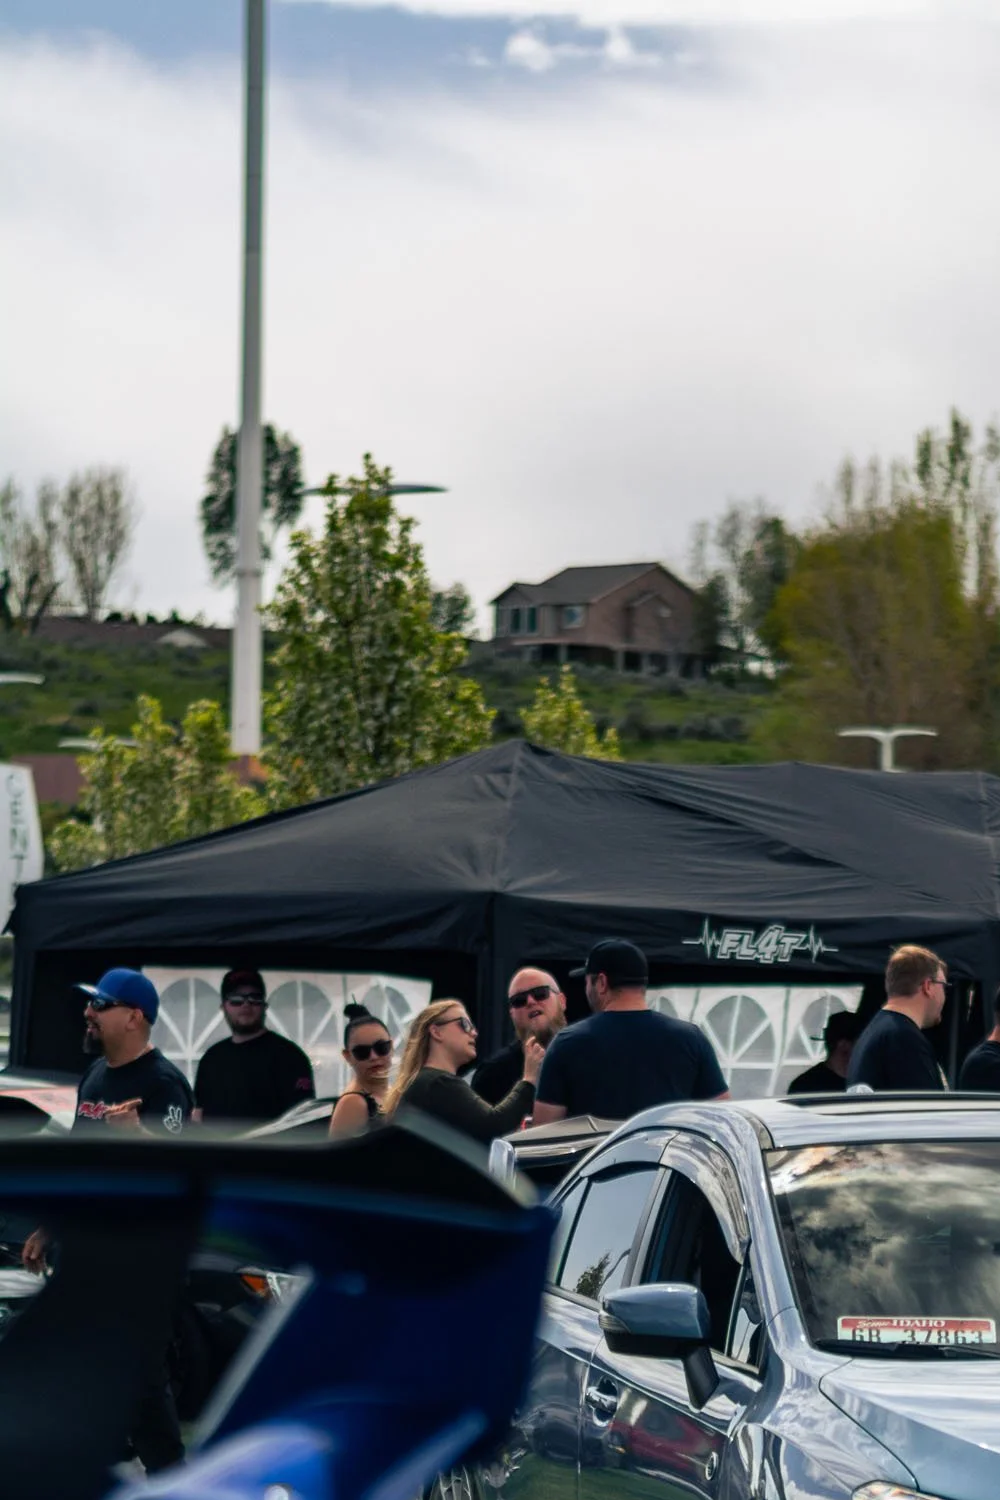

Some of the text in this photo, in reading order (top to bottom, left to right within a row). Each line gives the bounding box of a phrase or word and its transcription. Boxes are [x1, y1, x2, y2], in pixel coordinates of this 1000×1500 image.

[717, 925, 806, 963] FL4T
[891, 1319, 946, 1328] IDAHO
[903, 1329, 983, 1344] 37863
